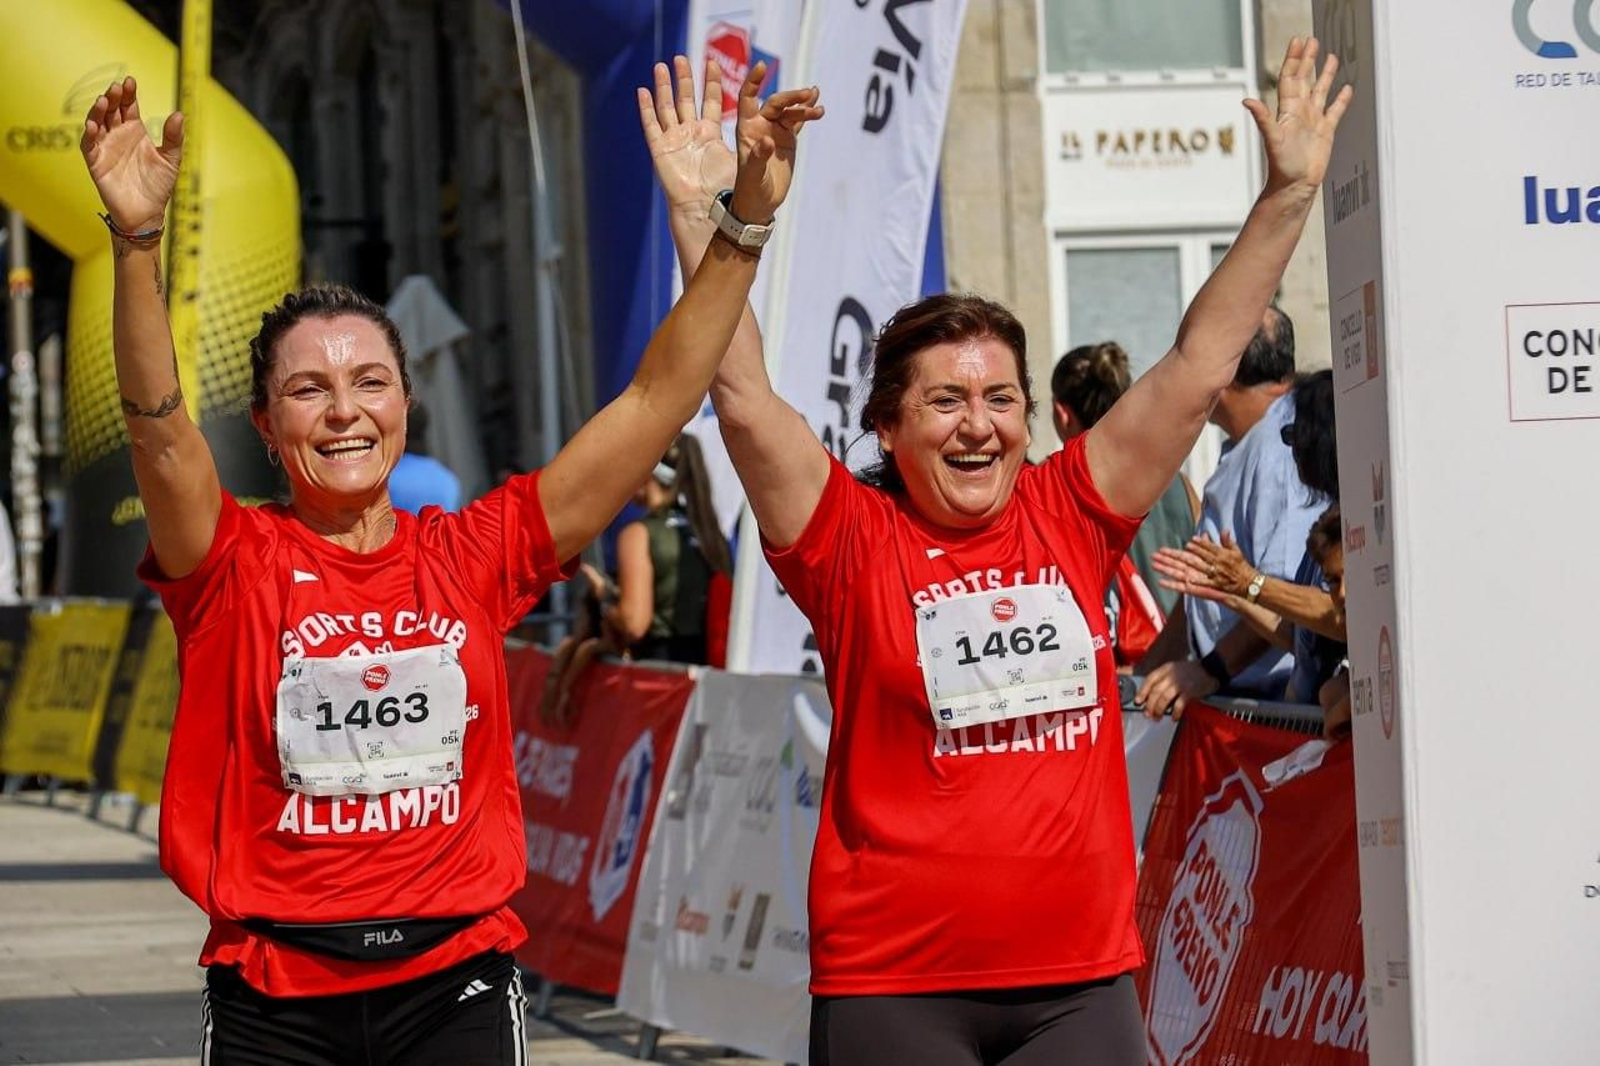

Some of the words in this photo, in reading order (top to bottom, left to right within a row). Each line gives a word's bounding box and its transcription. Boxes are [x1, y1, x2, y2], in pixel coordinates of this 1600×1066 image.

[1515, 73, 1546, 87] RED
[1551, 72, 1572, 86] DE
[1576, 71, 1600, 86] TA
[1096, 128, 1209, 154] PAPERO
[1523, 328, 1600, 358] CON
[1547, 365, 1593, 394] DE
[956, 623, 1060, 665] 1462
[315, 692, 430, 732] 1463
[441, 735, 460, 745] 05k
[276, 781, 460, 835] ALCAMPO
[364, 929, 404, 947] FILA
[1252, 965, 1324, 1040] HOY
[1313, 970, 1368, 1053] COR
